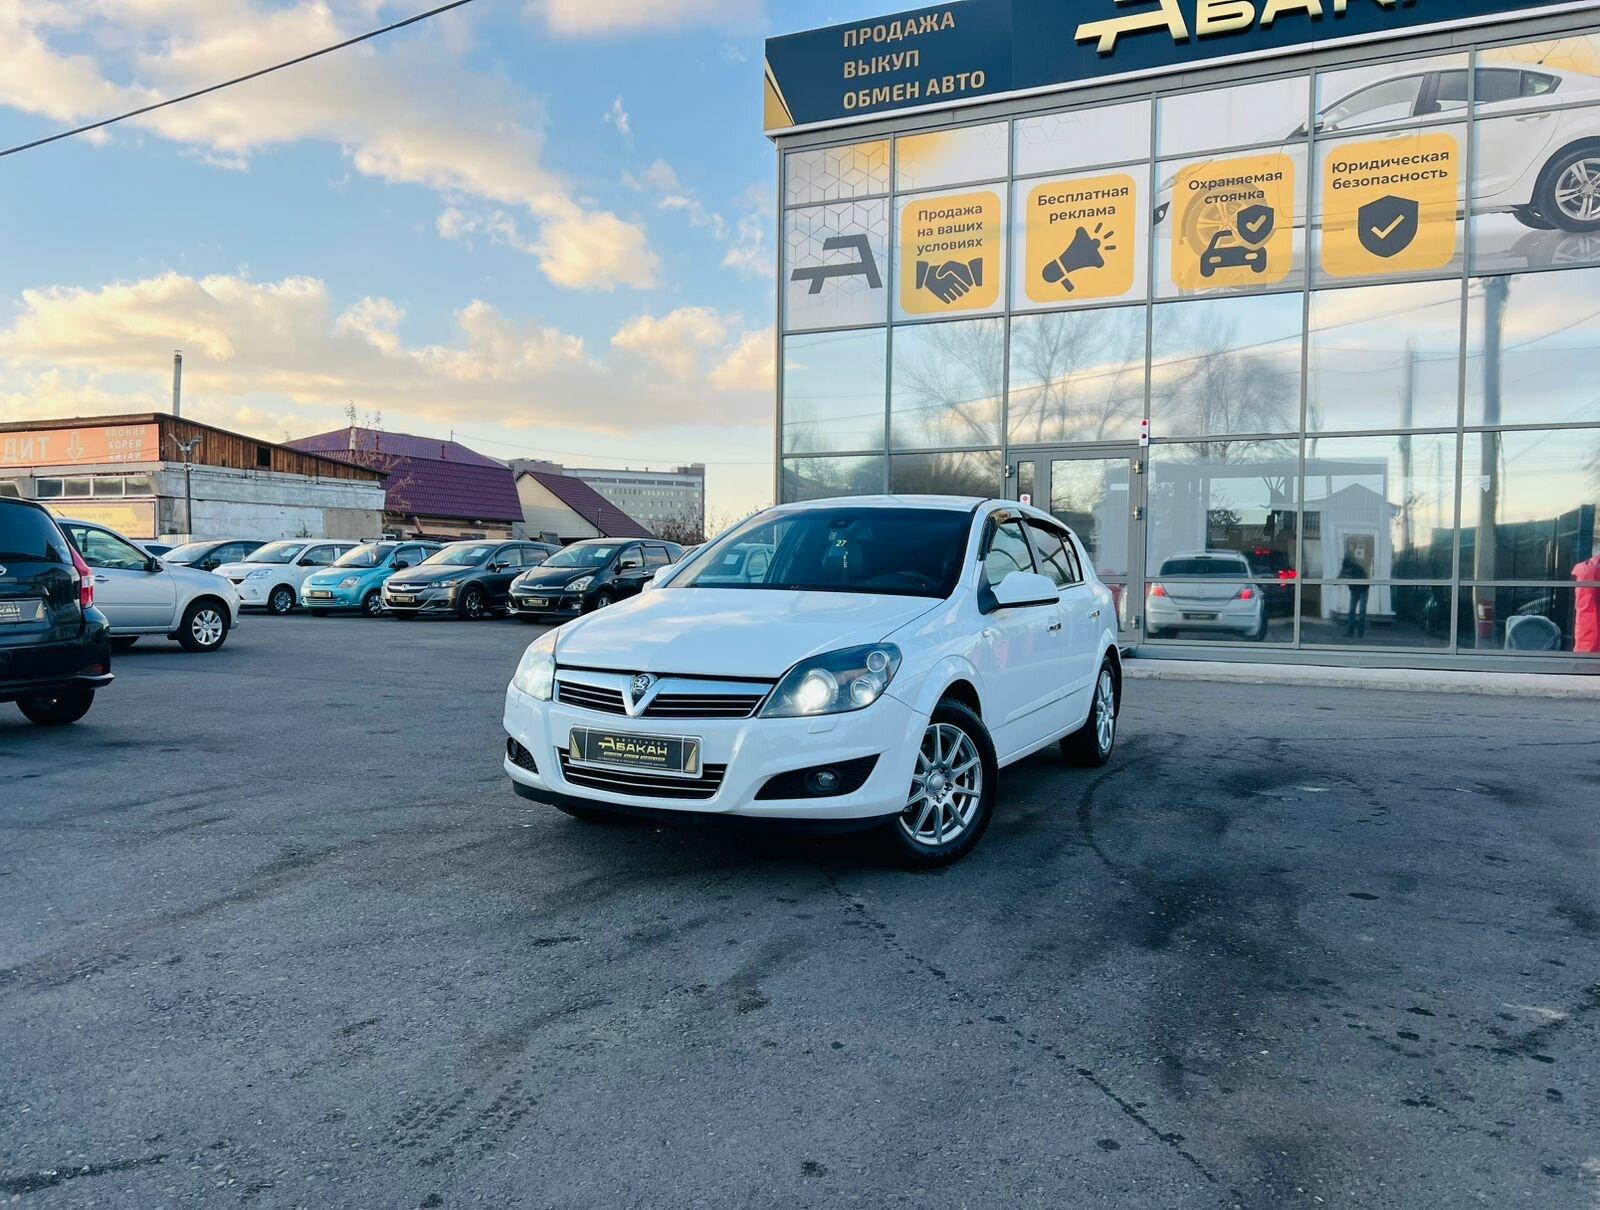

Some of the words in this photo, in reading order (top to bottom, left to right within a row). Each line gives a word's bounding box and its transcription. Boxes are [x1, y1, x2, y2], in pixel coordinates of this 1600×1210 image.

[843, 11, 955, 48] ПРОДАЖА
[843, 49, 919, 79] ВЫКУП
[843, 81, 919, 110] ОБМЕН
[925, 70, 985, 97] АВТО
[1331, 151, 1450, 174] Юридическая
[1188, 171, 1283, 192] Охраняемая
[1332, 168, 1448, 191] безопасность
[1037, 185, 1129, 207] Бесплатная
[1204, 189, 1265, 205] стоянка
[918, 203, 983, 222] Продажа
[1049, 204, 1116, 224] реклама
[916, 228, 934, 238] на
[937, 220, 983, 237] ваших
[916, 236, 983, 255] условиях
[108, 438, 142, 449] КОРЕЯ
[598, 736, 667, 755] АБАКАН
